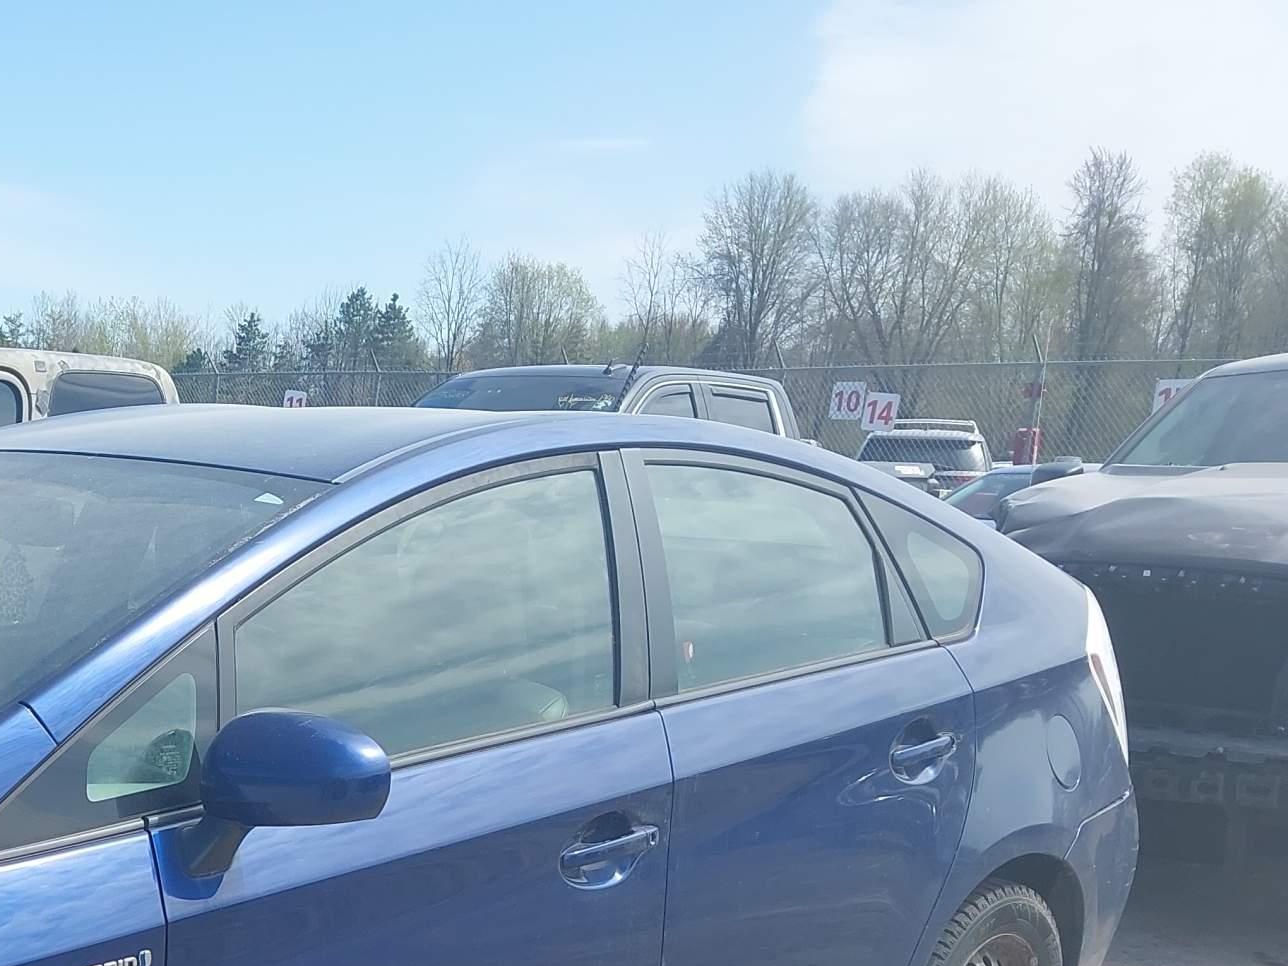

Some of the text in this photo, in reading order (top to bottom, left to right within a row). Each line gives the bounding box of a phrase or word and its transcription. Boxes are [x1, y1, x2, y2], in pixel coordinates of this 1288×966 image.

[286, 396, 303, 408] 11
[834, 390, 861, 412] 10
[867, 399, 894, 425] 14
